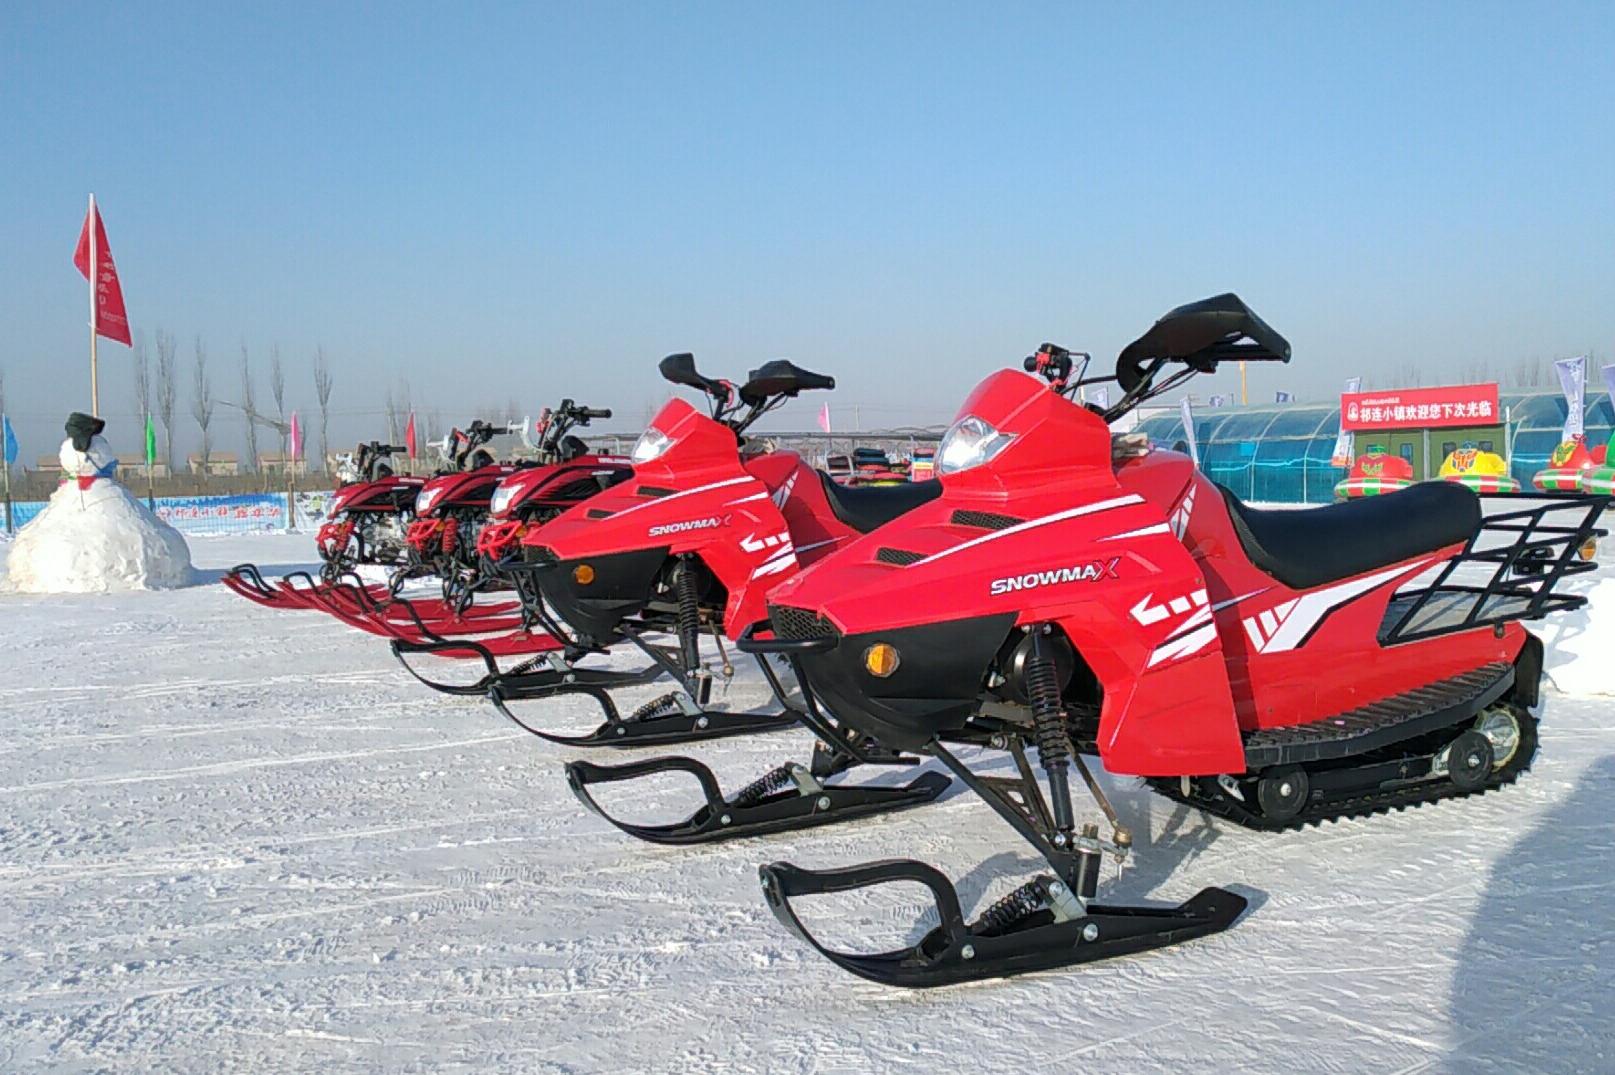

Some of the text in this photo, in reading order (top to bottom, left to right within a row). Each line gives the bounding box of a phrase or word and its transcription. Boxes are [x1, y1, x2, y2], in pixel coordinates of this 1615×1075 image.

[1360, 400, 1492, 422] 祁连小镇欢迎您下次光临
[648, 513, 732, 537] SNOWMAX
[990, 556, 1121, 595] SNOWMAX
